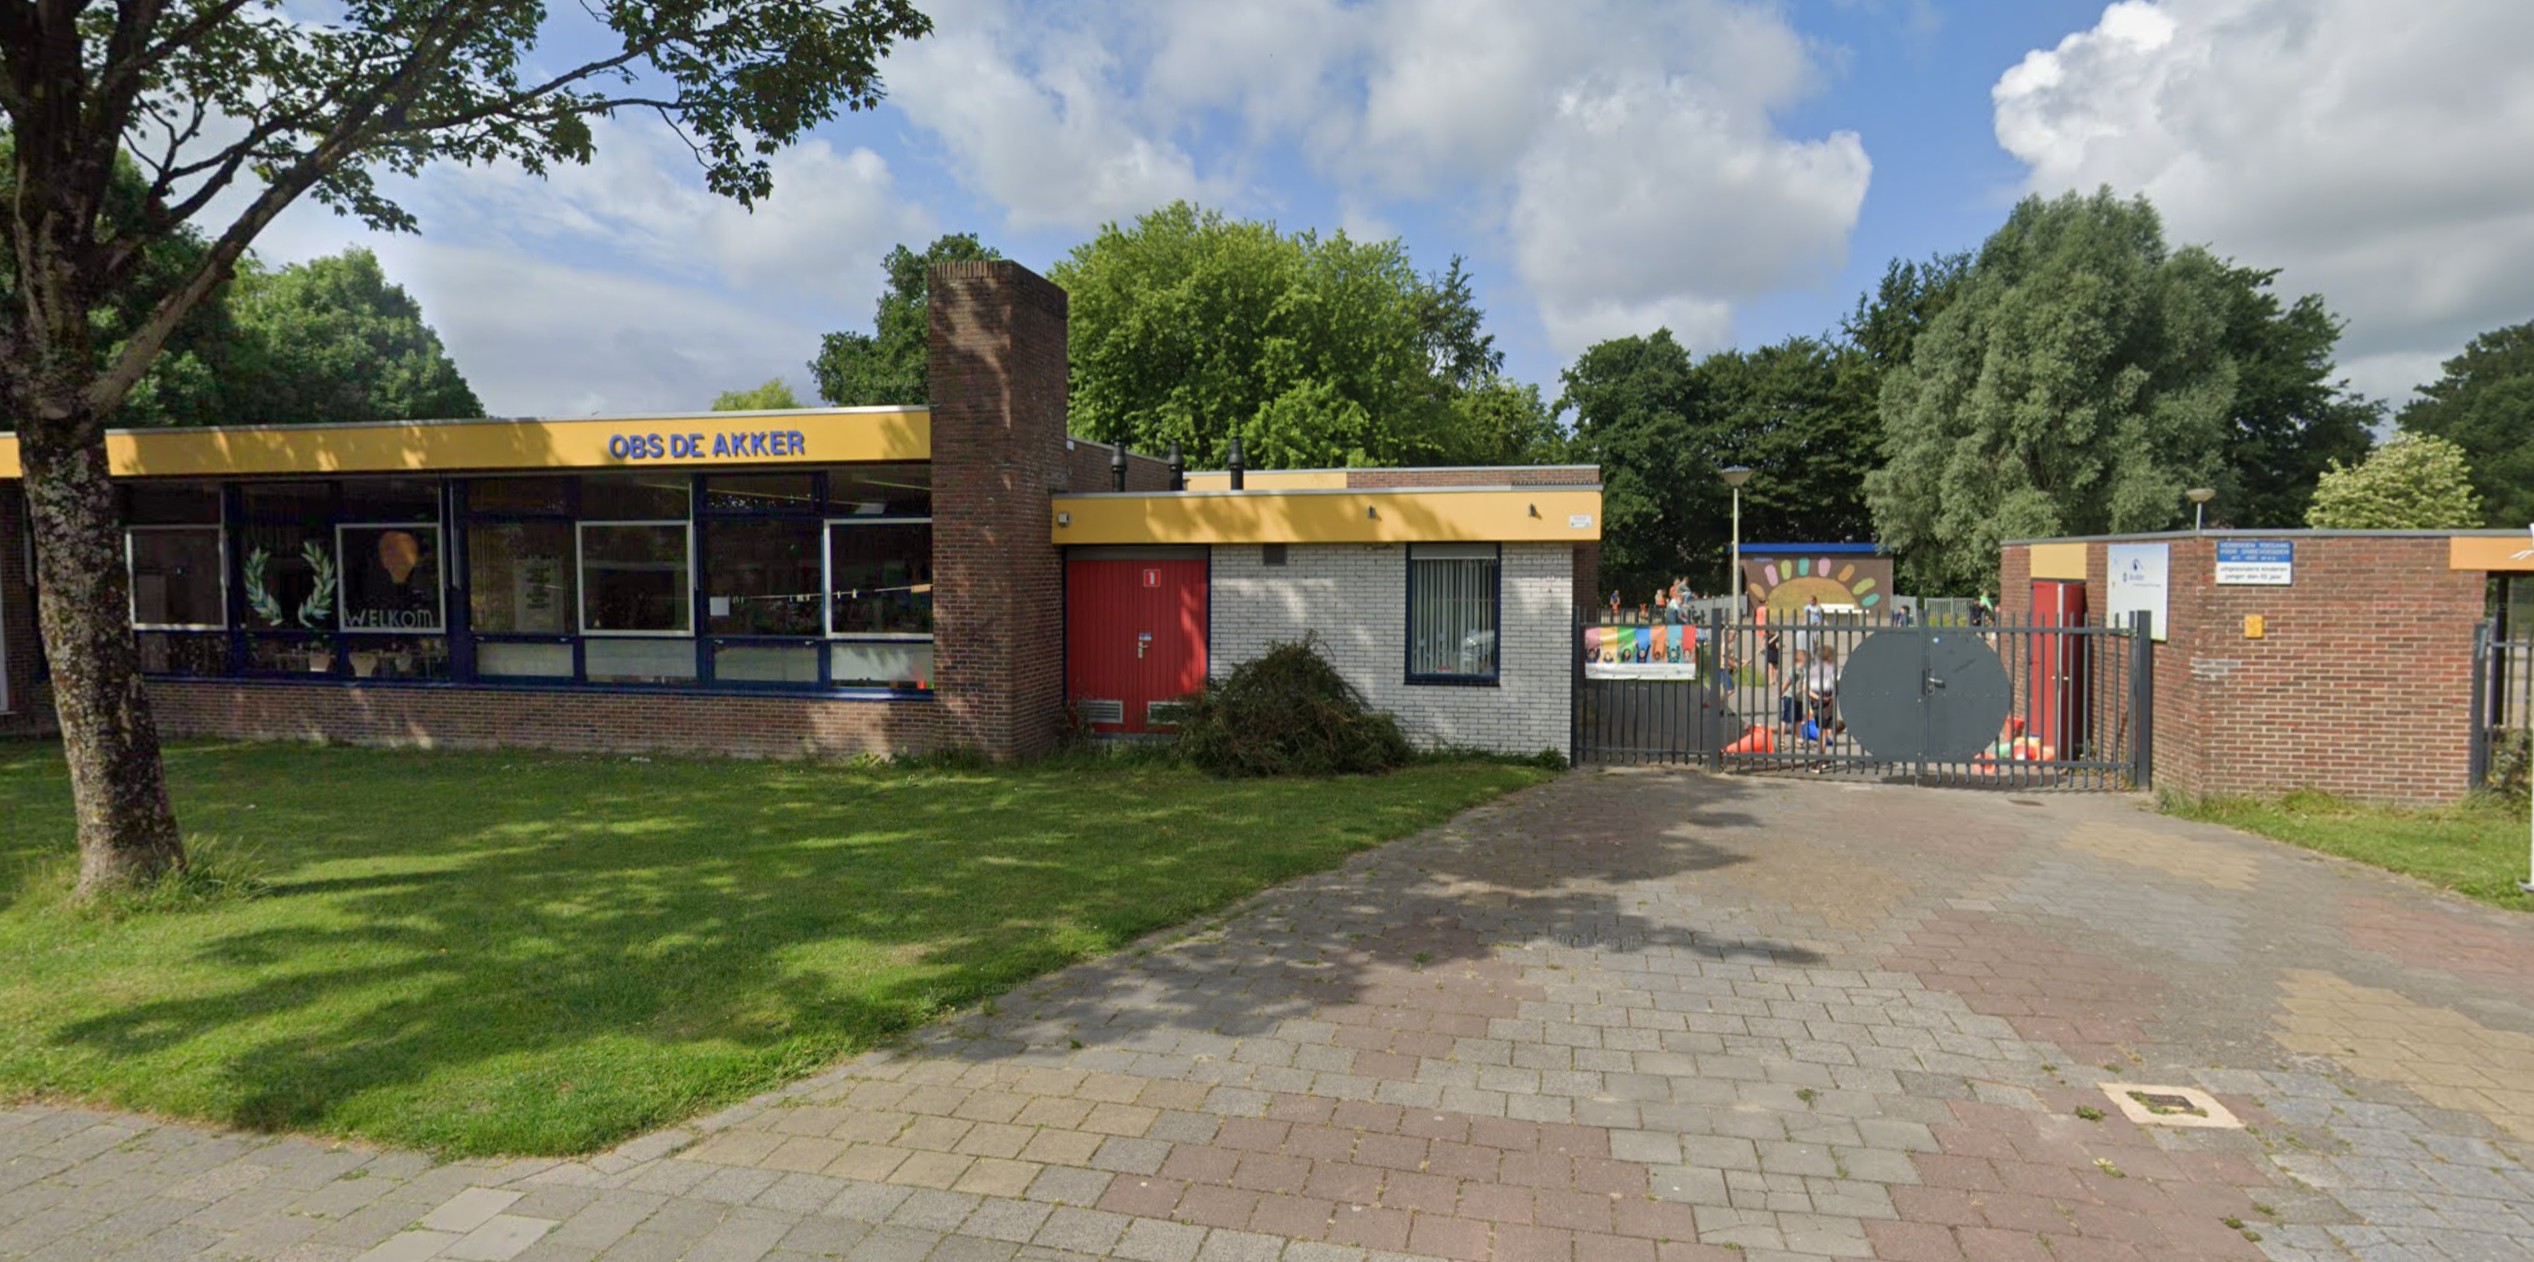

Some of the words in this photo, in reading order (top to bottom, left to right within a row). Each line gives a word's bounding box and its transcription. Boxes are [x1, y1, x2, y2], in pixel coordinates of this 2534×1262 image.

[608, 434, 664, 459] OBS
[670, 432, 705, 458] DE
[712, 430, 805, 457] AKKER
[345, 609, 433, 628] WELKOM
